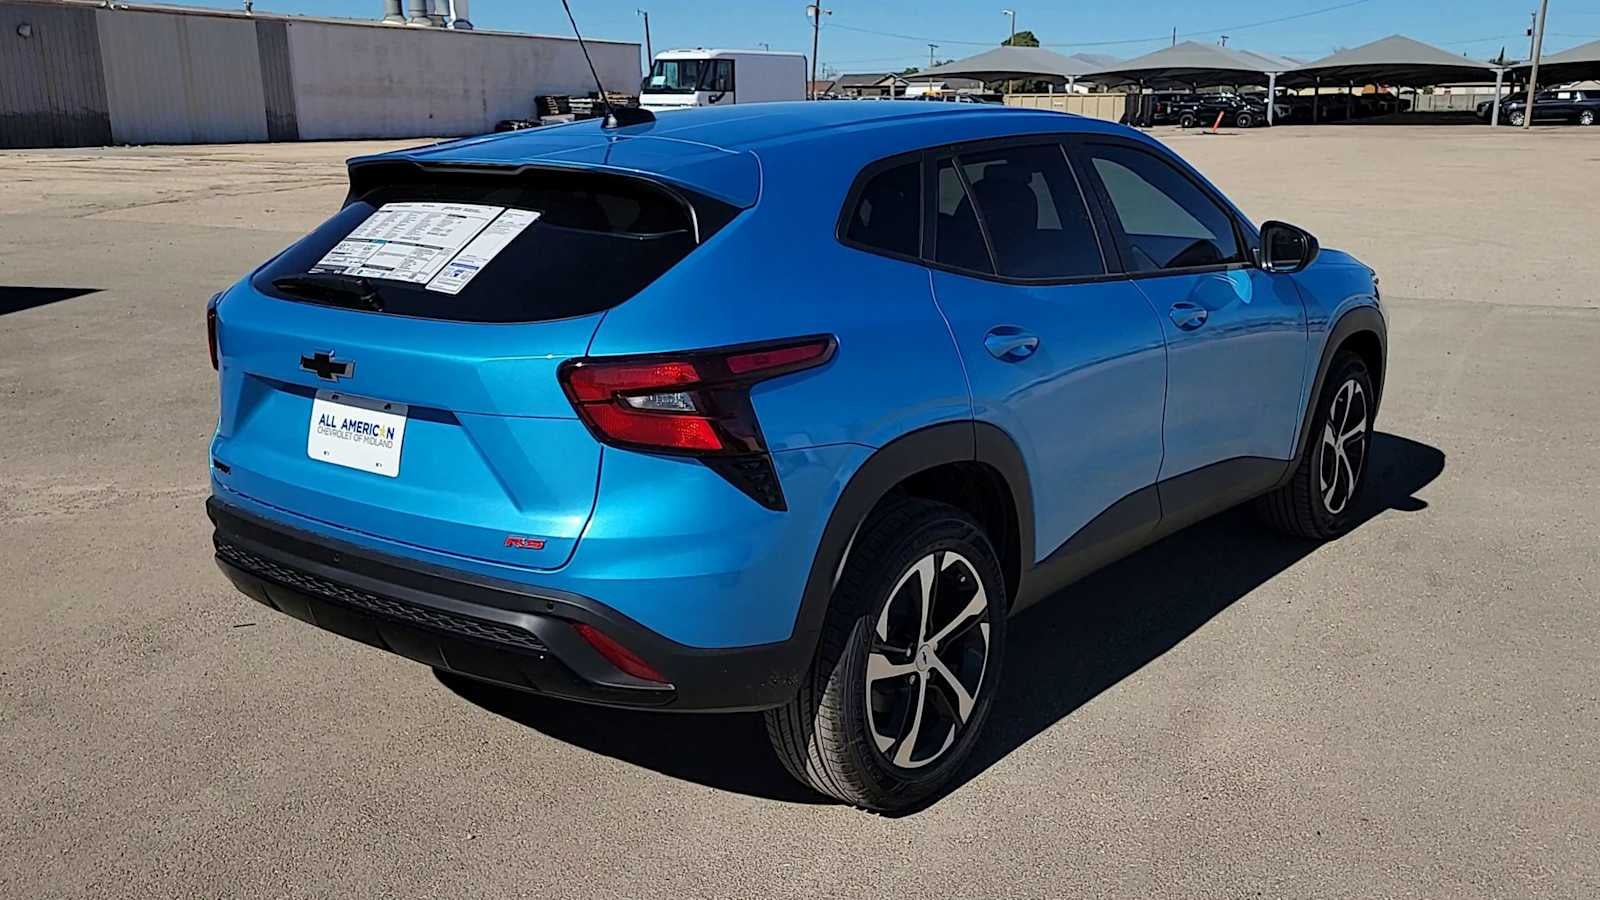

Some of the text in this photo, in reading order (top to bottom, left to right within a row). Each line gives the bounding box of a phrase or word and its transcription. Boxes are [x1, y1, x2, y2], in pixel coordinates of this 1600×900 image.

[318, 413, 337, 429] ALL
[316, 426, 394, 449] CHEVROLET OF MIDLAND
[504, 534, 546, 551] RS
